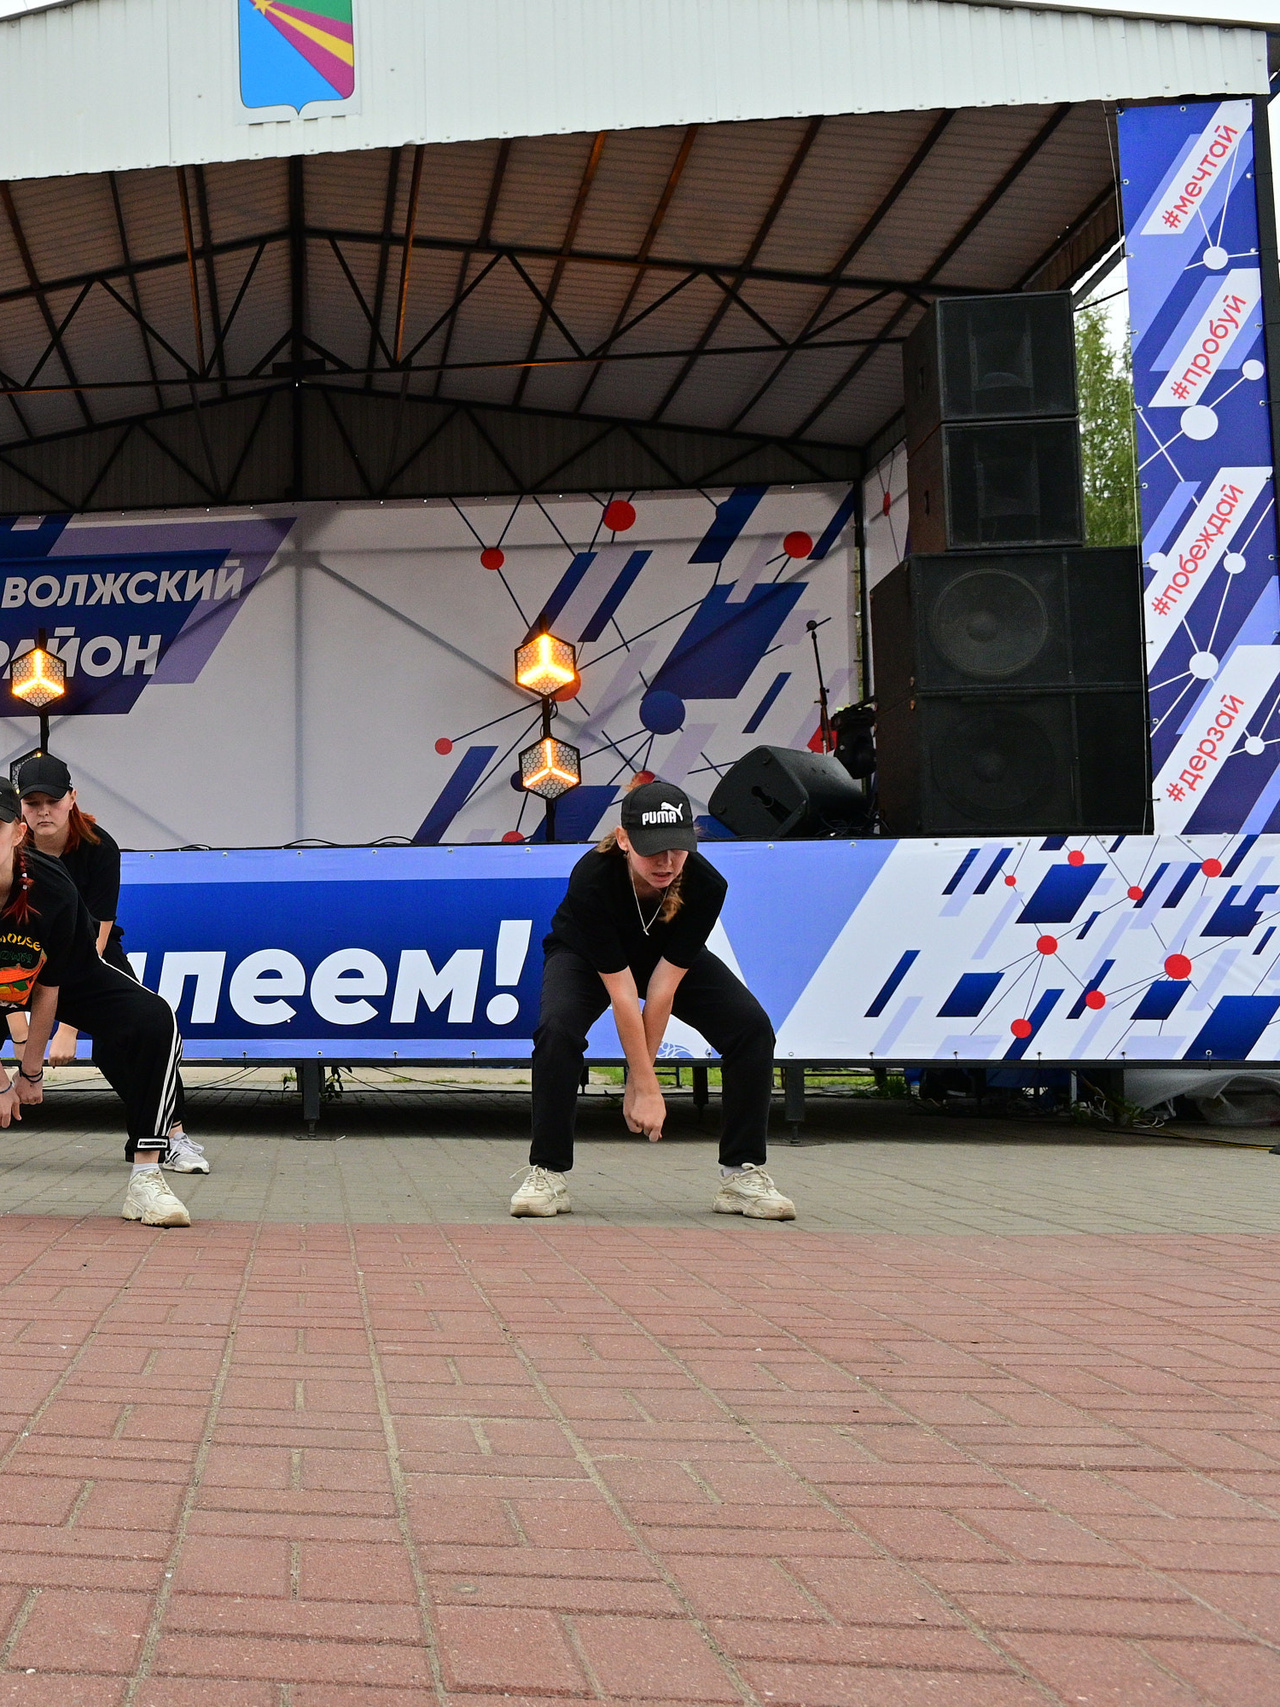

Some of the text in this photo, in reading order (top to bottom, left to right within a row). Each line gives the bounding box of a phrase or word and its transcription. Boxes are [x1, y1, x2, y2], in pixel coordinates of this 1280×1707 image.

[1162, 124, 1238, 229] #мечтай
[1171, 295, 1246, 400] #пробуй
[1151, 483, 1245, 616] #побеждай
[1166, 694, 1245, 802] #дерзай
[641, 810, 677, 826] PUMA
